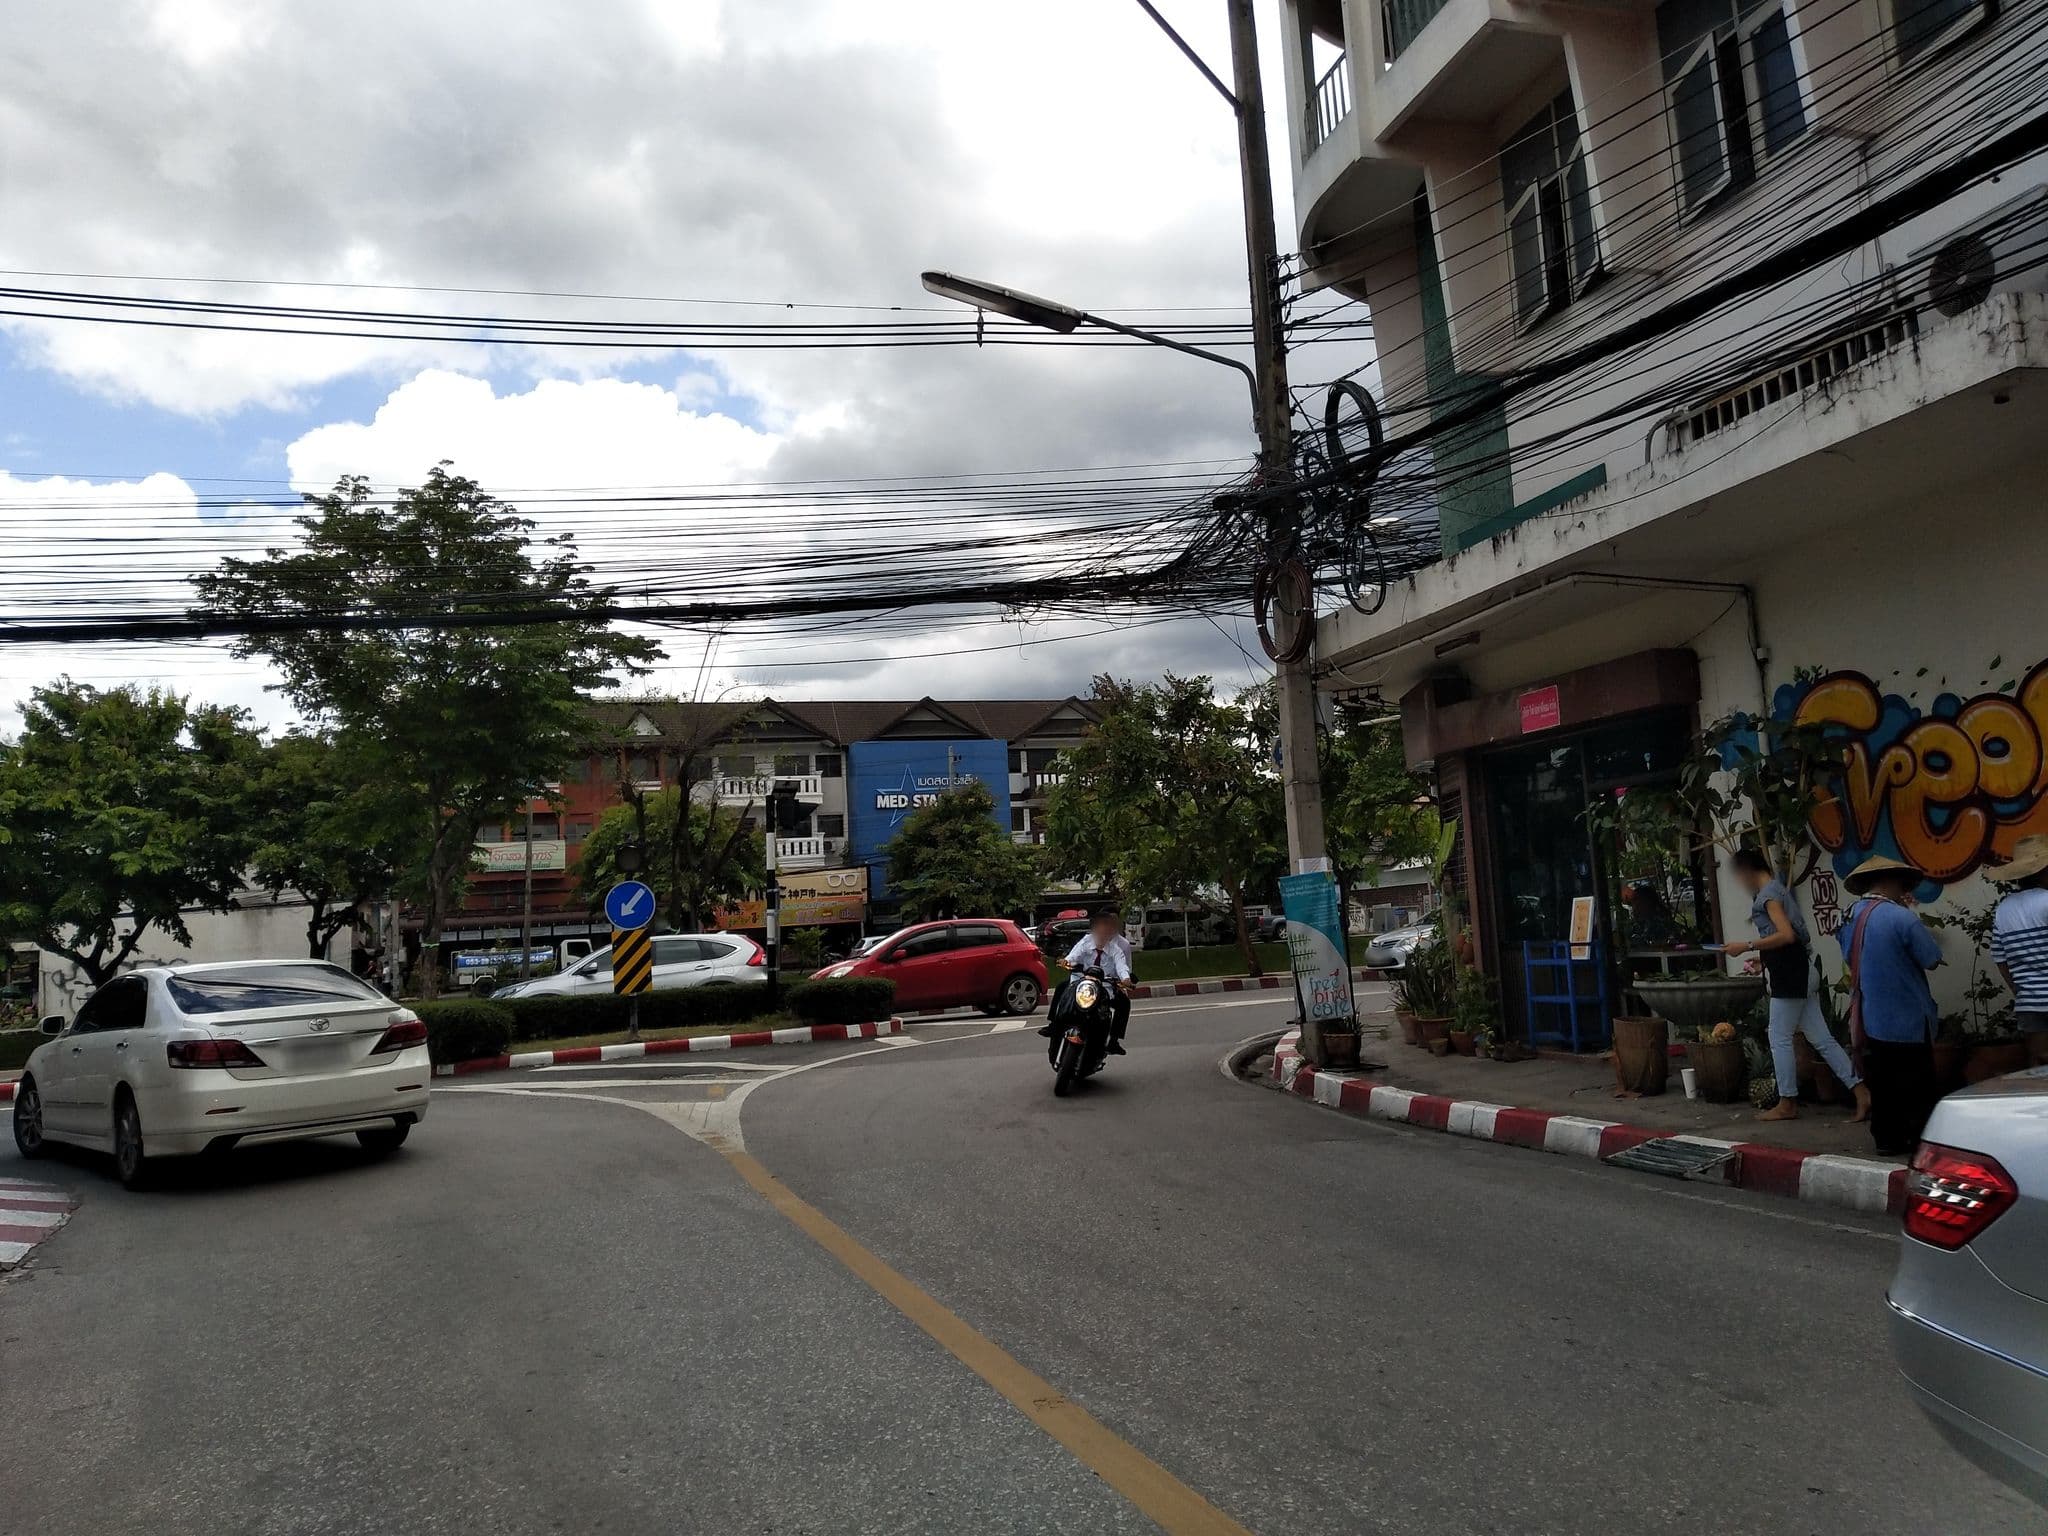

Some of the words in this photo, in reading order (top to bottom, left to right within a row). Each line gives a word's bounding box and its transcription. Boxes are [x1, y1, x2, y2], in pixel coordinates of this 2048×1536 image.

[877, 795, 908, 809] MED
[912, 794, 943, 809] STA
[1309, 976, 1340, 994] free
[1314, 985, 1348, 1004] bird
